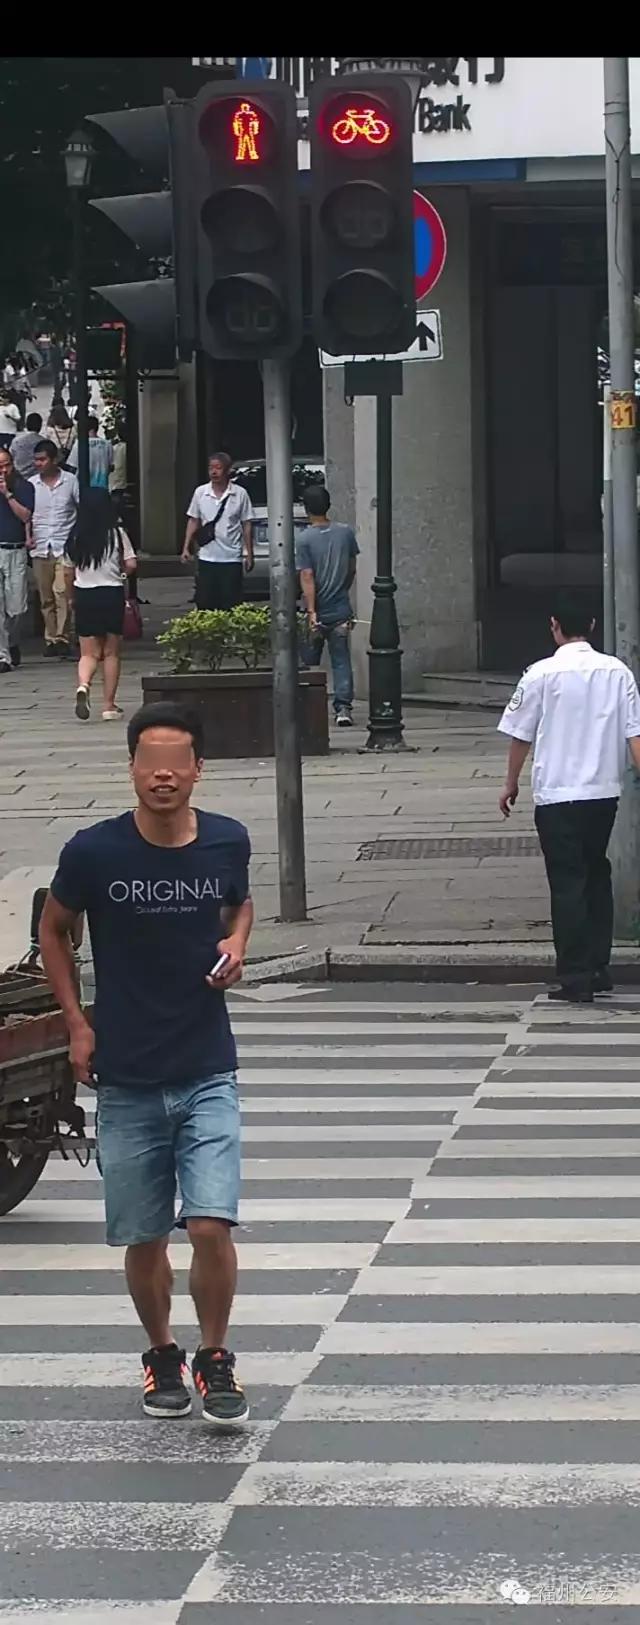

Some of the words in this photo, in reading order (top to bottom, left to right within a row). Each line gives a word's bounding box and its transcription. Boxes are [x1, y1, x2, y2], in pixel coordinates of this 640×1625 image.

[419, 95, 471, 132] Bank
[611, 405, 633, 426] 41
[108, 878, 222, 902] ORIGINAL
